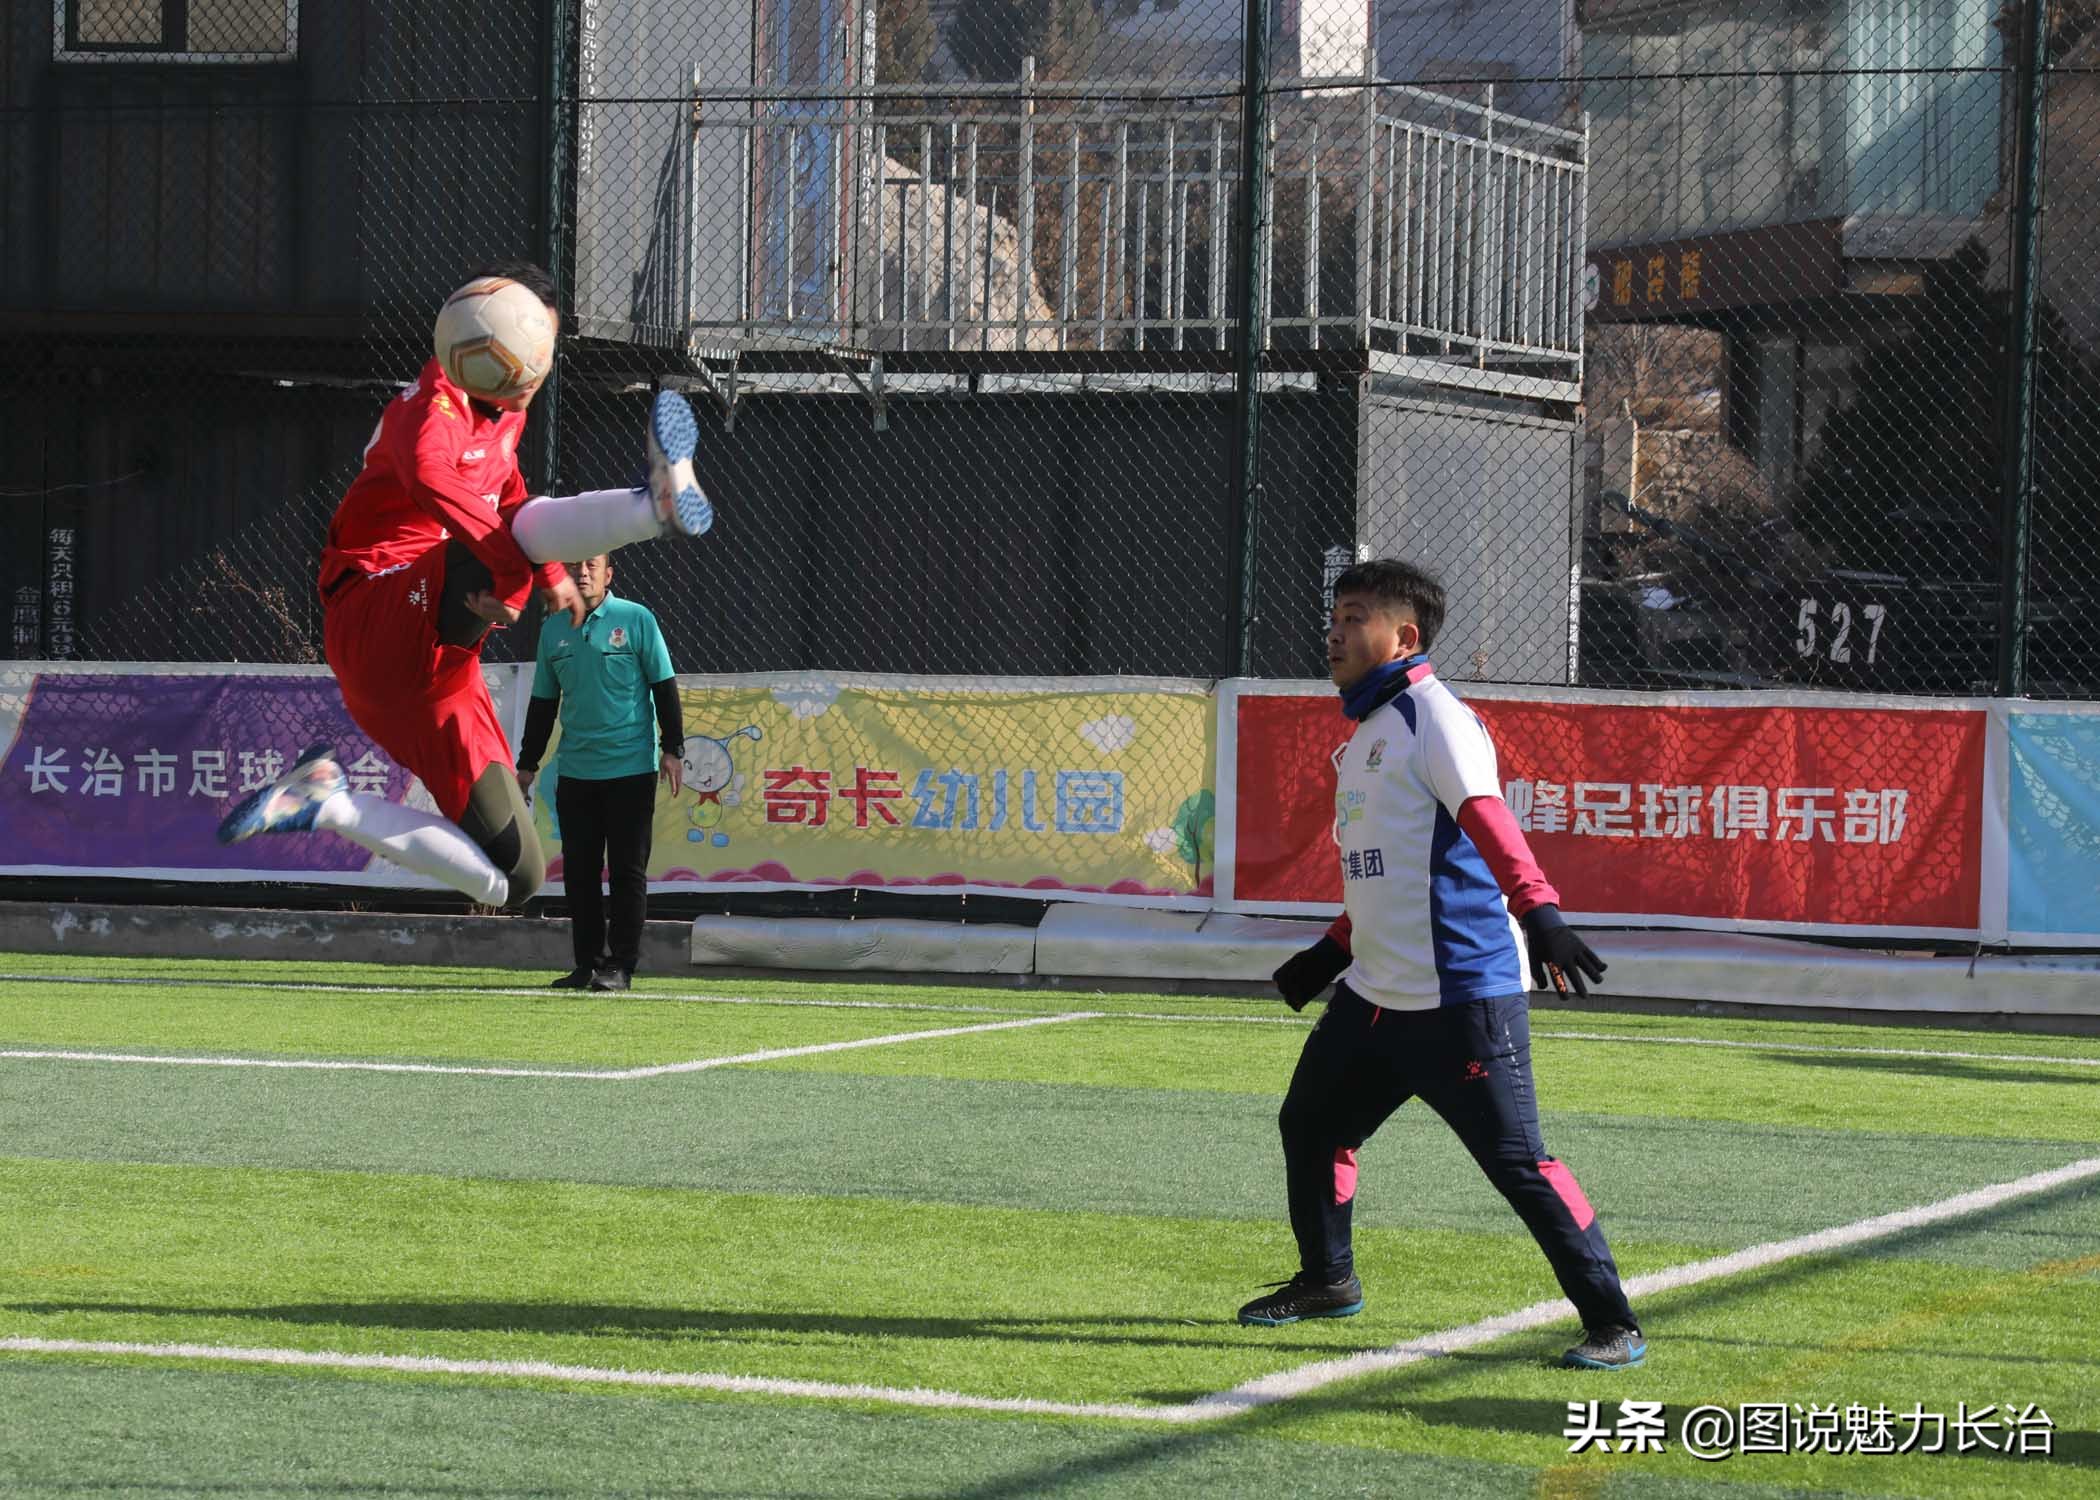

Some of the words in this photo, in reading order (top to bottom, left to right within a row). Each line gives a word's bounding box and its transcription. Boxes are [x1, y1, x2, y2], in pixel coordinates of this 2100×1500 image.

[1796, 598, 1887, 666] 527
[24, 746, 392, 799] 长治市足球会
[763, 766, 1125, 834] 奇卡幼儿园
[1505, 778, 1911, 846] 蜂足球俱乐部
[1342, 847, 1385, 881] 集团
